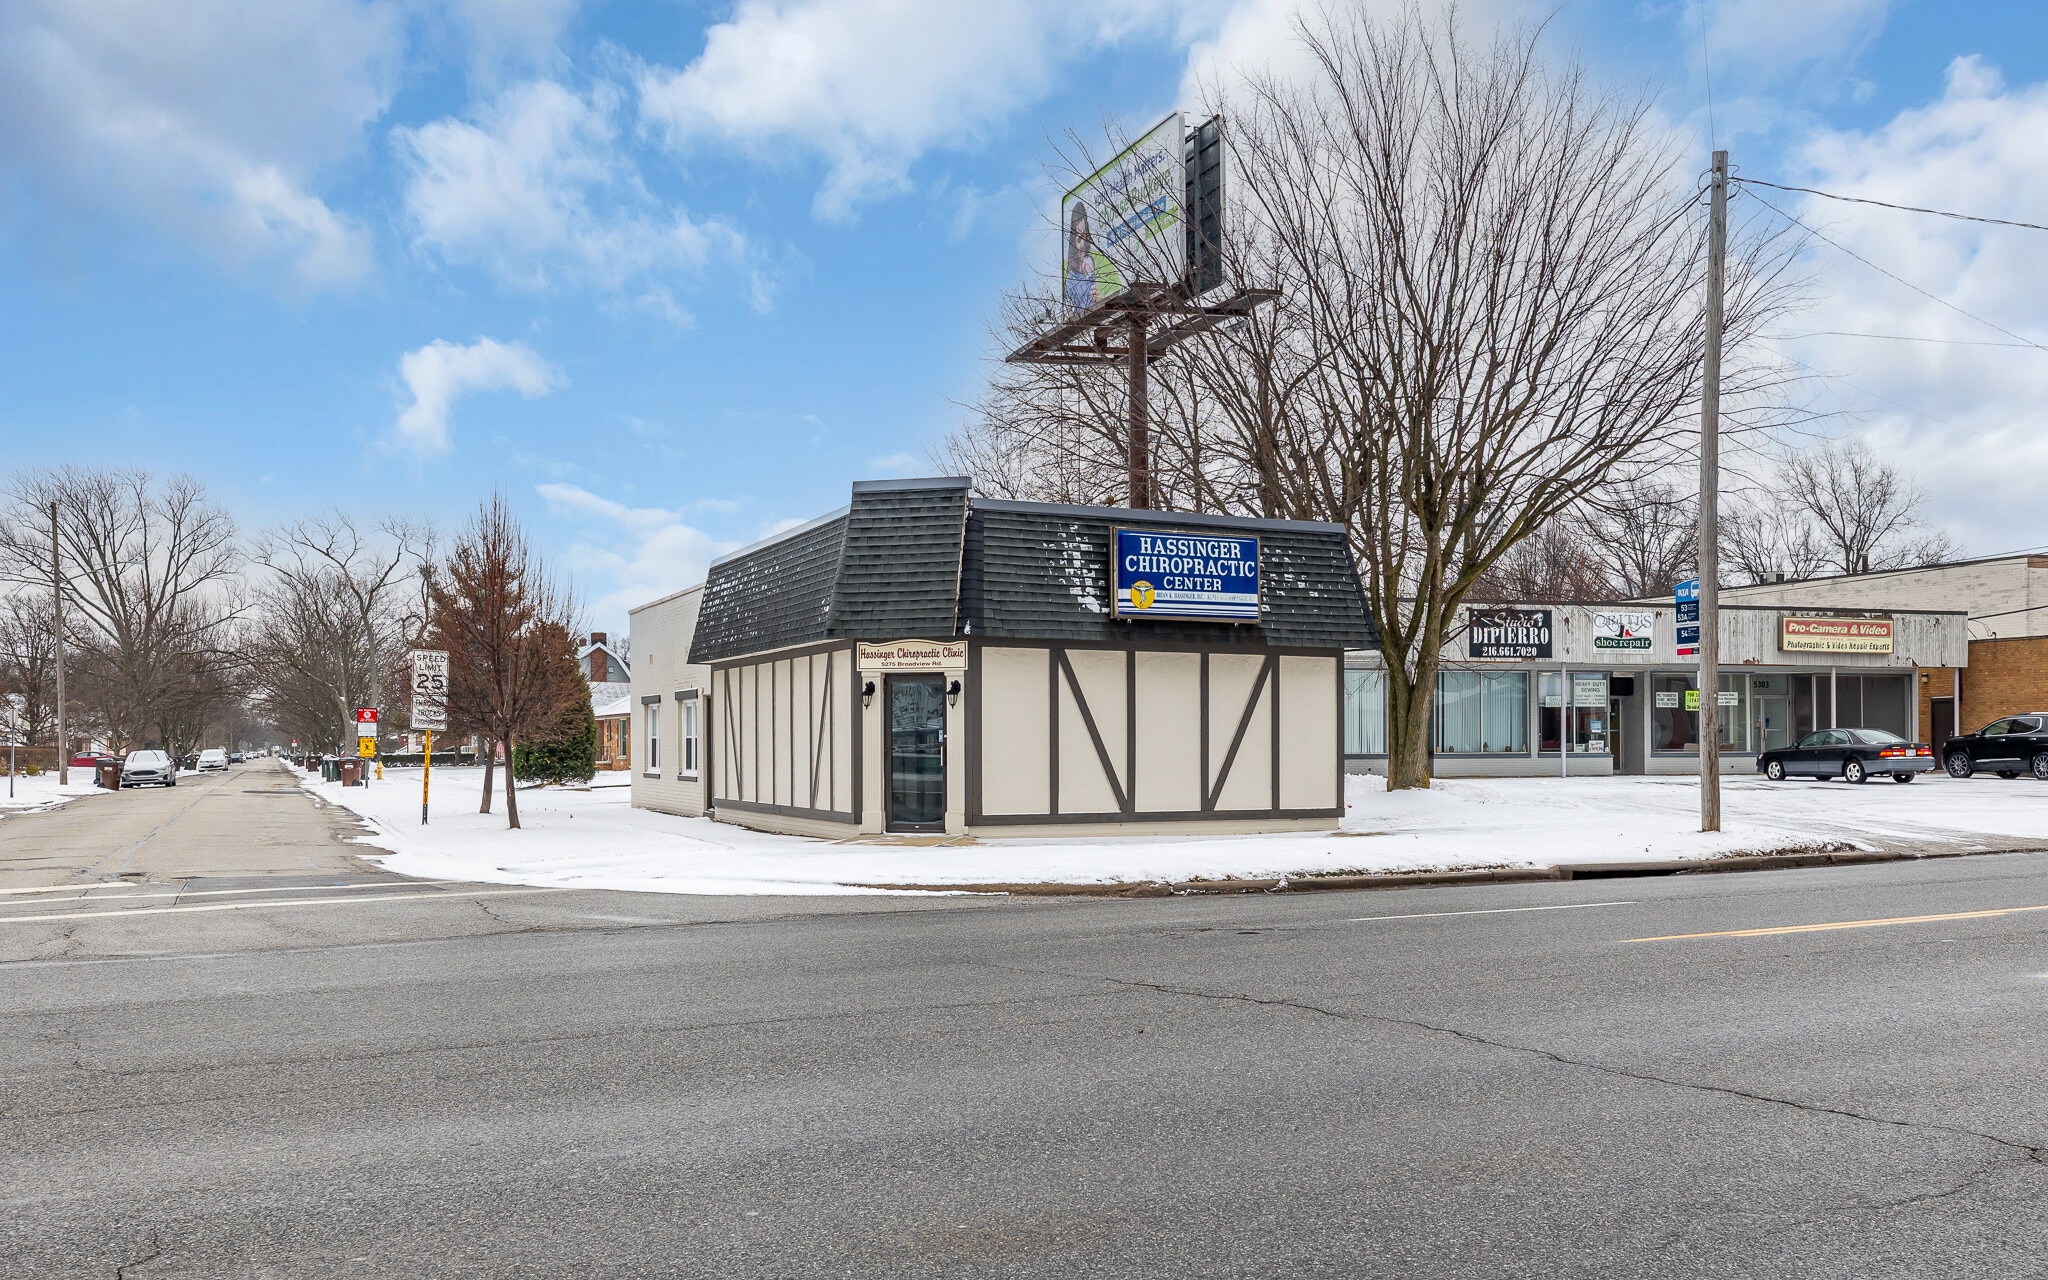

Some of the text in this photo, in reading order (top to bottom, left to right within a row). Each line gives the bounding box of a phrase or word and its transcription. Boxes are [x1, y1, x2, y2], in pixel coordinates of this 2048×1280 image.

[1140, 537, 1241, 558] HASSINGER
[1125, 555, 1255, 577] CHIROPRACTIC
[1163, 576, 1222, 591] CENTER
[1681, 604, 1688, 612] 53
[1495, 612, 1534, 628] Studio
[1677, 613, 1688, 621] 53A
[1681, 630, 1688, 638] 54
[1850, 625, 1859, 634] &
[1860, 625, 1888, 635] Video
[1595, 638, 1650, 649] shoe repair
[1786, 641, 1824, 649] Photographic
[1849, 642, 1868, 650] Repair
[1869, 643, 1890, 651] Experts
[861, 646, 964, 662] Hassinger Chiropractic Clinic
[1482, 646, 1537, 657] 216.661.7020
[416, 654, 446, 663] SPEED
[419, 664, 442, 672] LIMIT
[417, 673, 444, 690] 25
[1753, 680, 1769, 688] 5303
